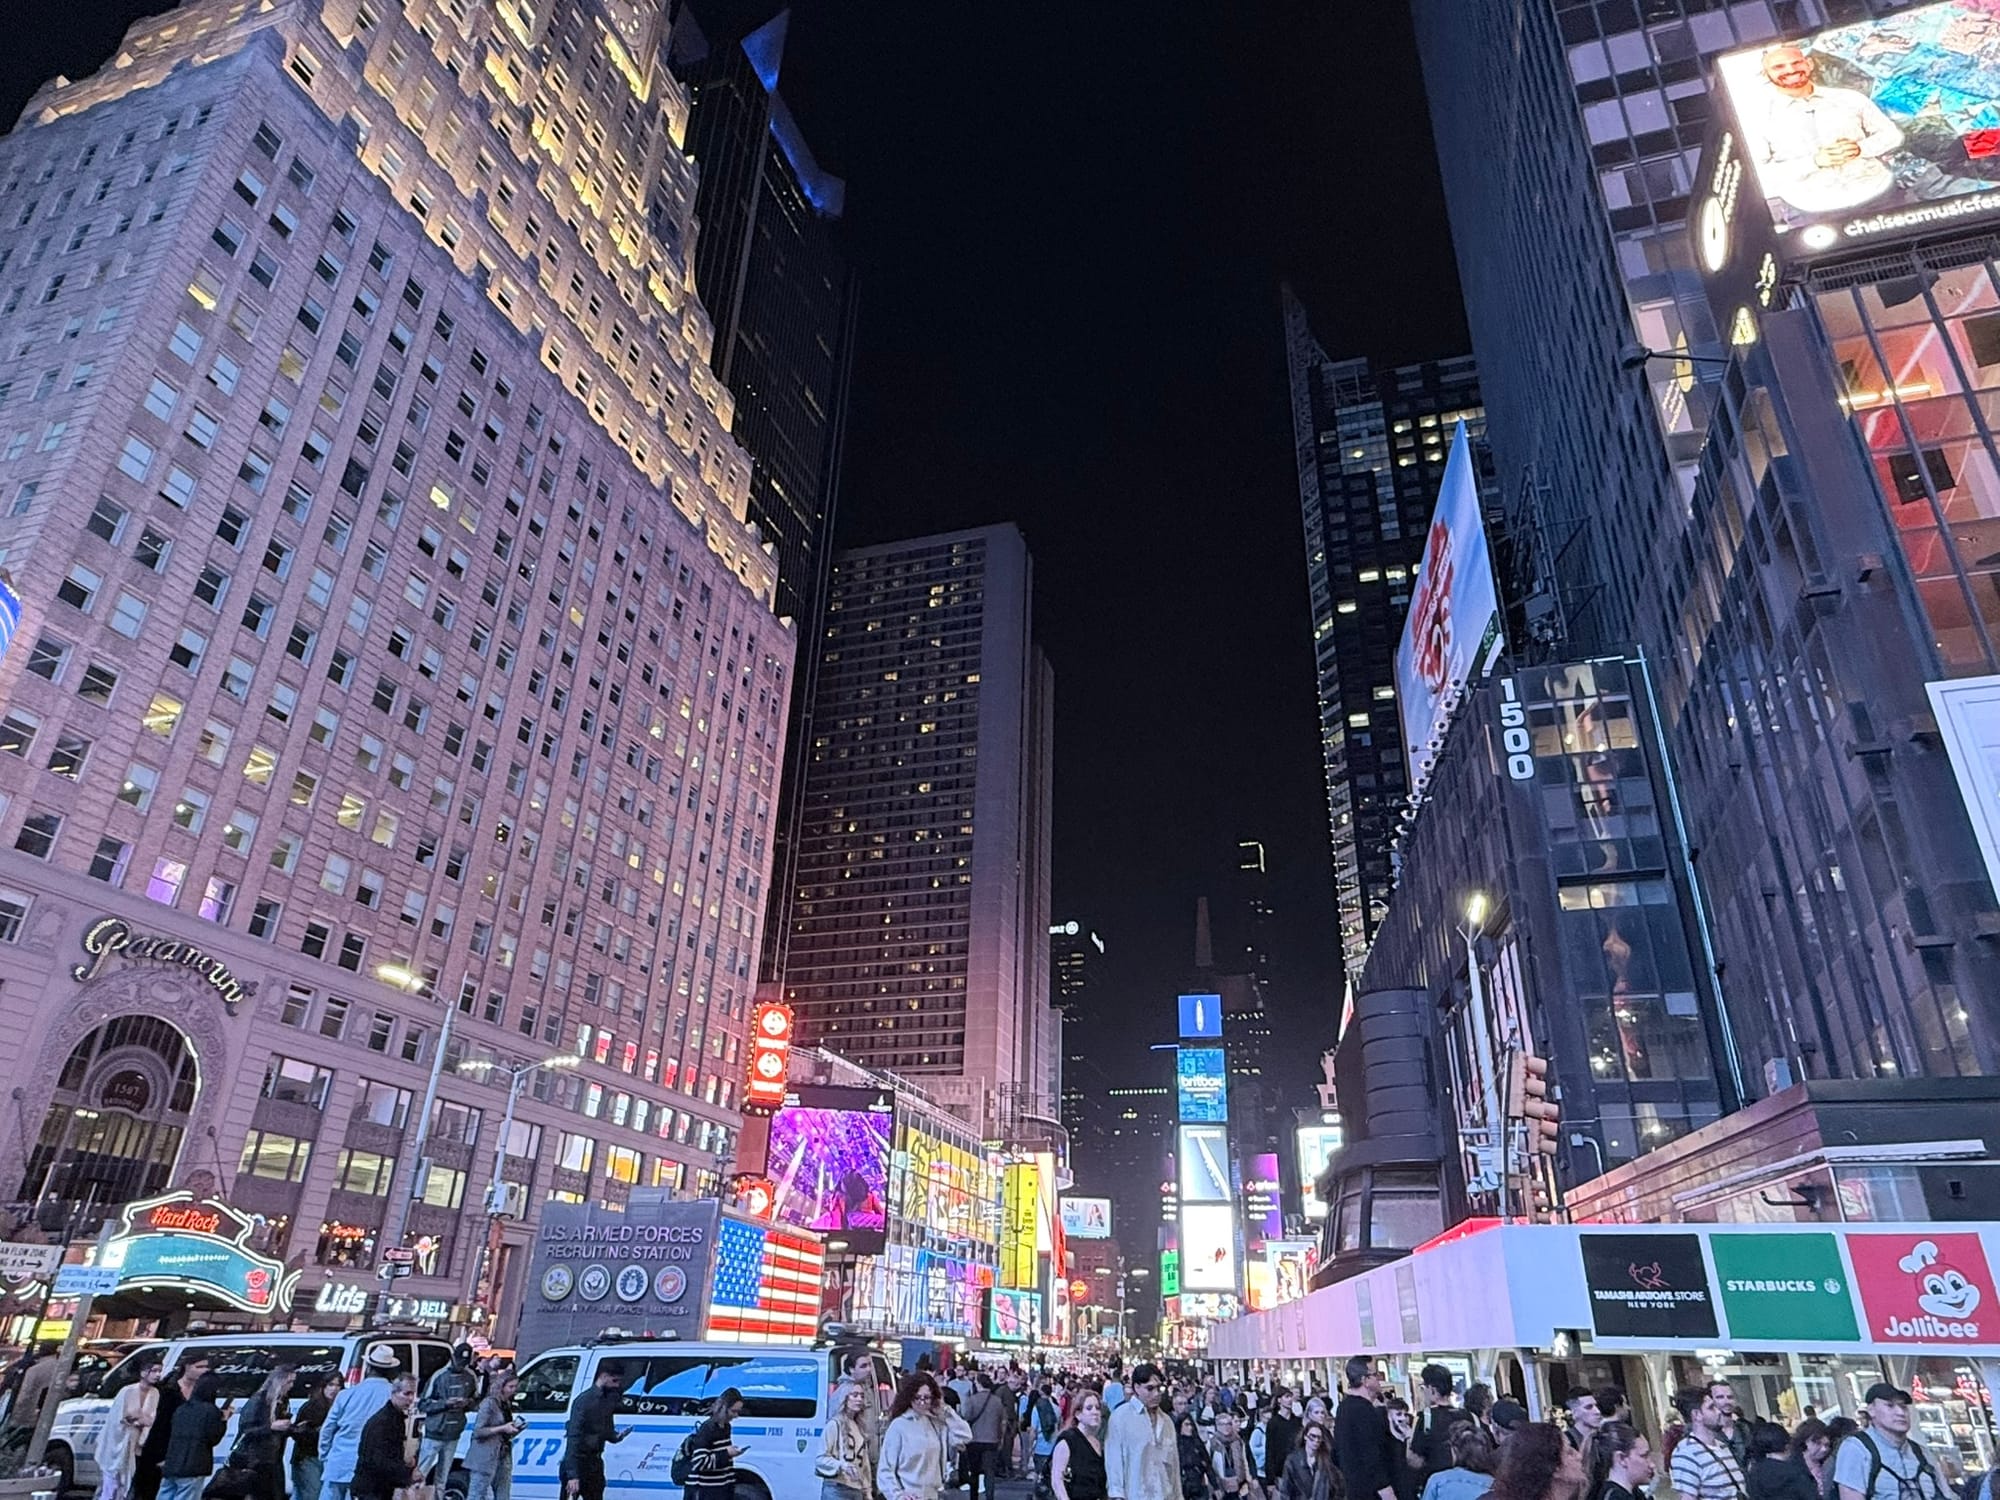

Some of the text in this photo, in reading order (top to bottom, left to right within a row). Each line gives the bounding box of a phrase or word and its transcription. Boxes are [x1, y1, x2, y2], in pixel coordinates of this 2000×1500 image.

[1500, 678, 1534, 780] 1500
[71, 918, 257, 1016] Paramount
[151, 1206, 220, 1233] Hard Rock
[542, 1225, 704, 1244] U.S. ARMED FORCES
[546, 1245, 693, 1261] RECRUITING STATION
[1726, 1280, 1816, 1292] STARBUCKS
[315, 1282, 369, 1314] Lids
[1627, 1301, 1676, 1309] NEW YORK
[1674, 1291, 1706, 1302] STORE
[420, 1300, 448, 1318] BELL
[1884, 1315, 1979, 1338] Jollibee
